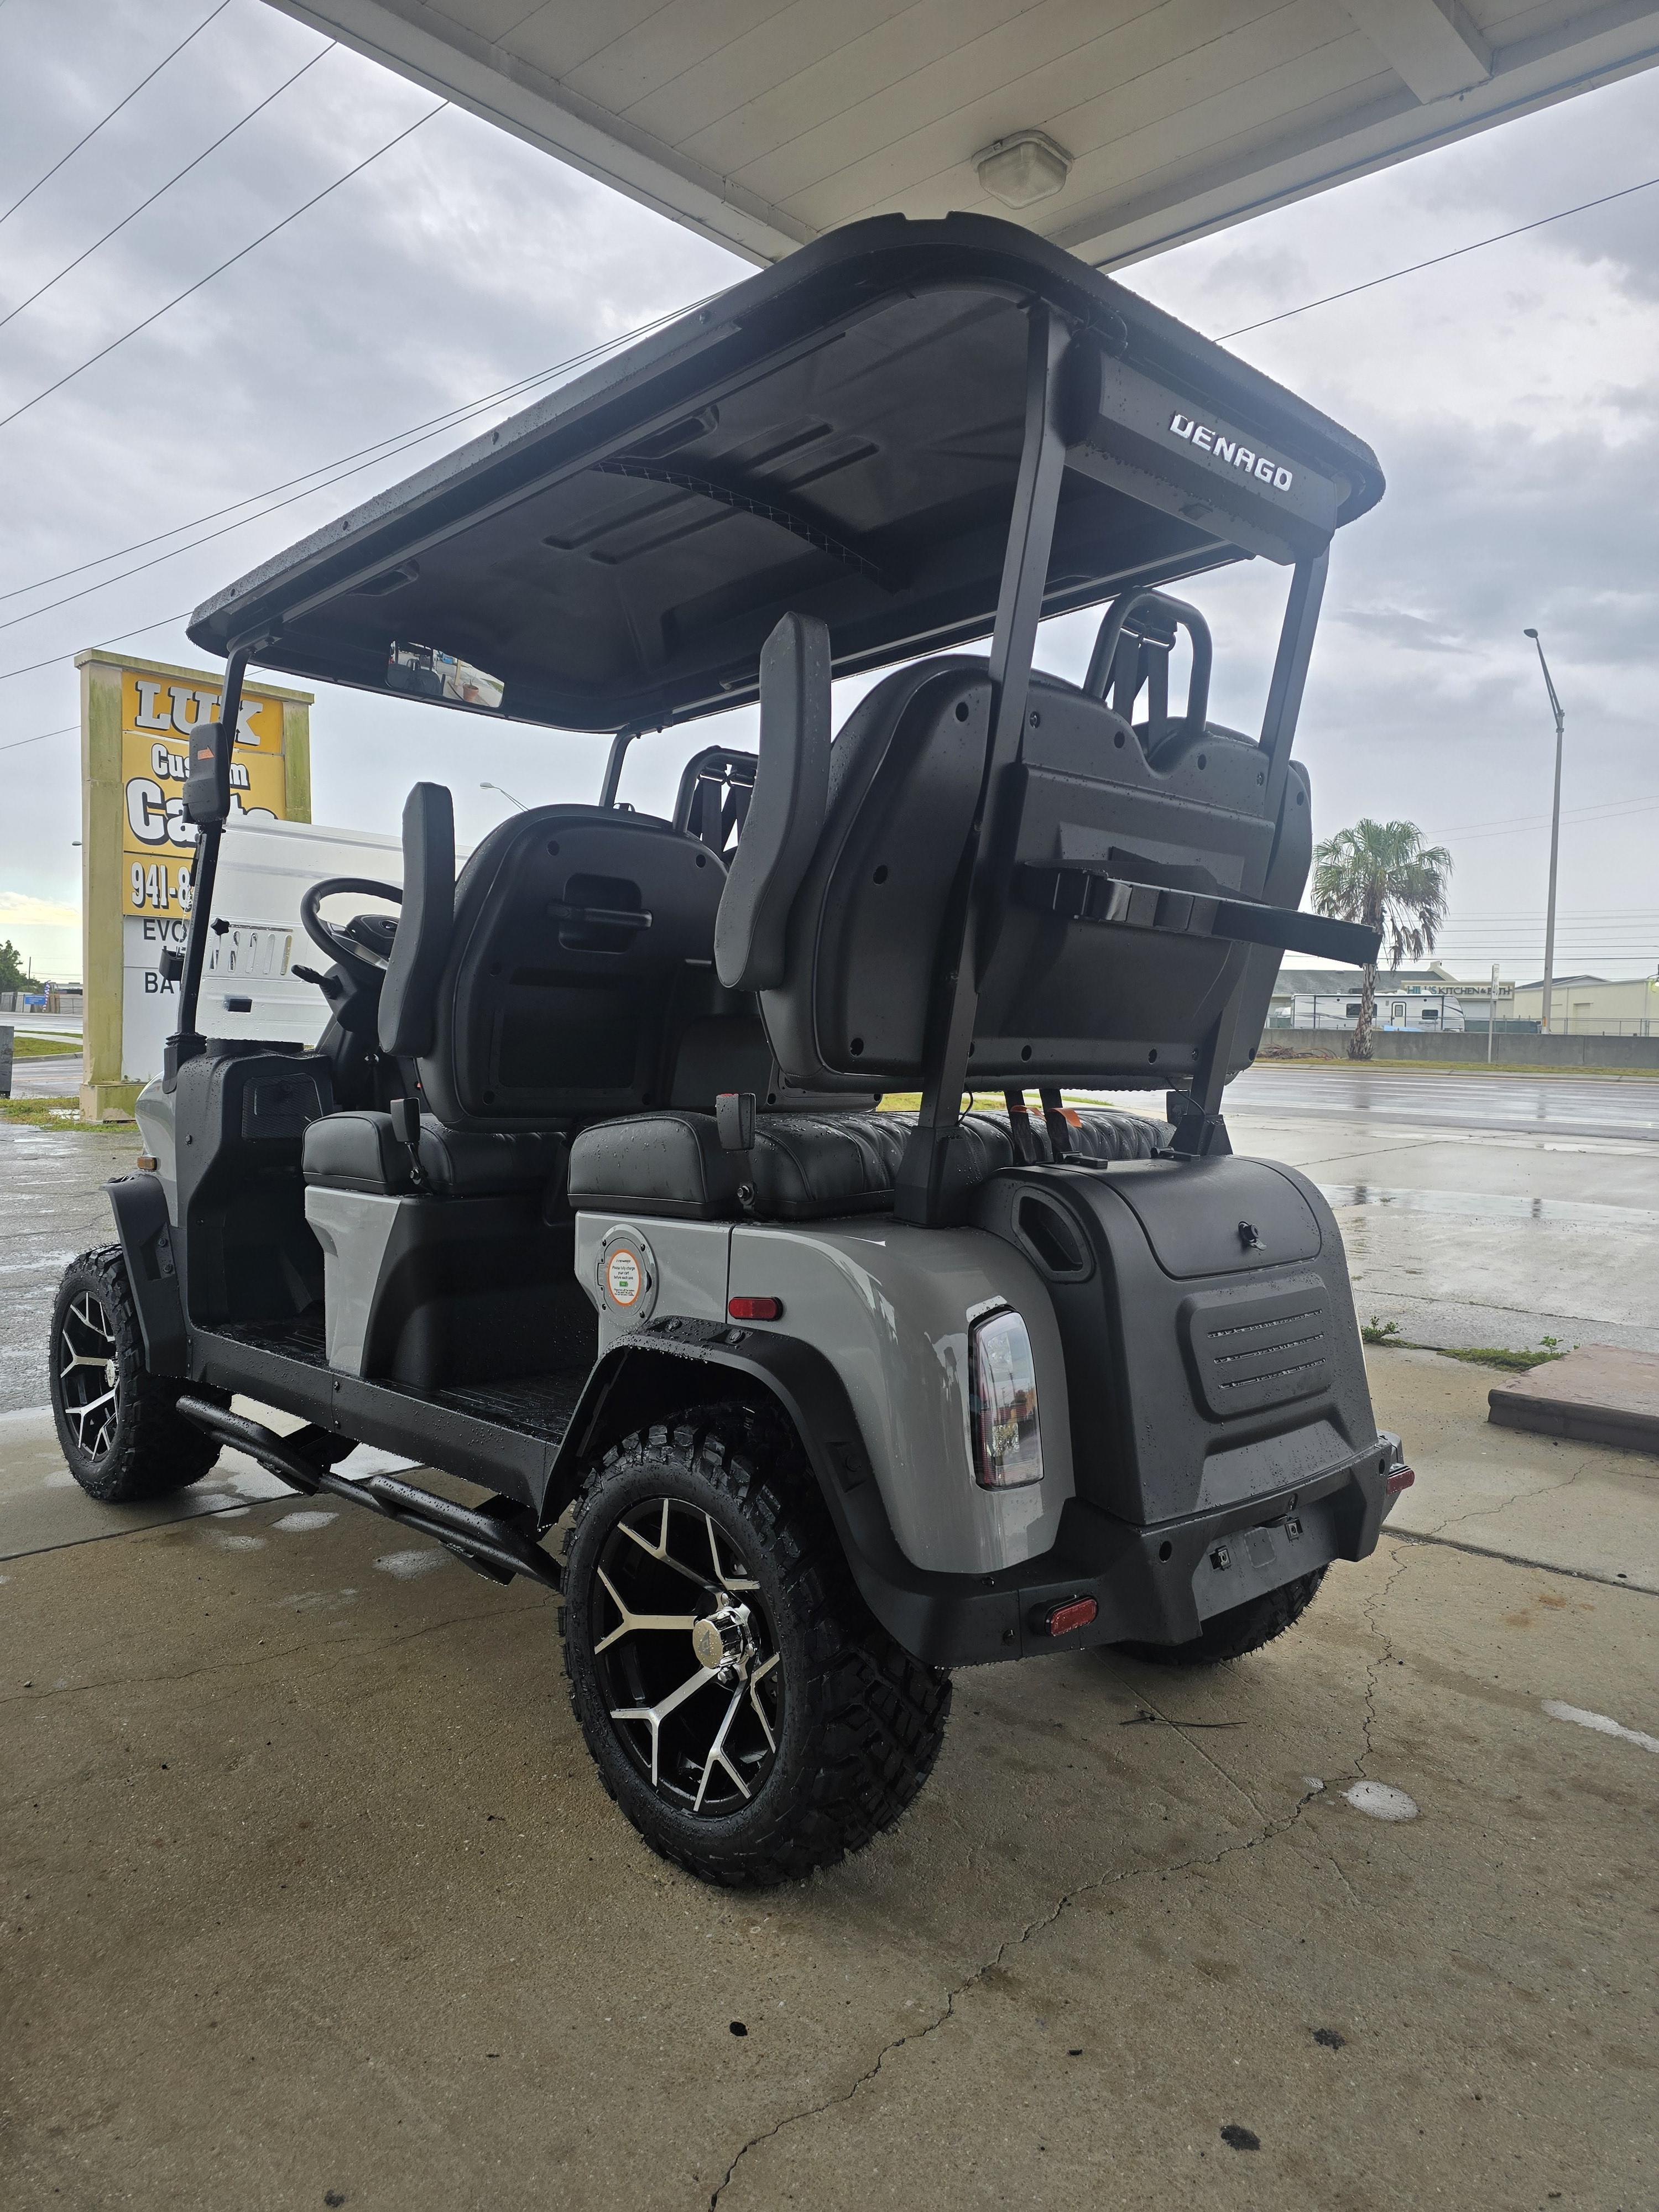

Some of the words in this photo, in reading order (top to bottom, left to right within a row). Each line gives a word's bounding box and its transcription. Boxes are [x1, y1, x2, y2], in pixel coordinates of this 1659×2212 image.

[1170, 414, 1293, 492] DENAGO
[1438, 987, 1479, 995] KITCHEN
[1487, 986, 1510, 995] BTH
